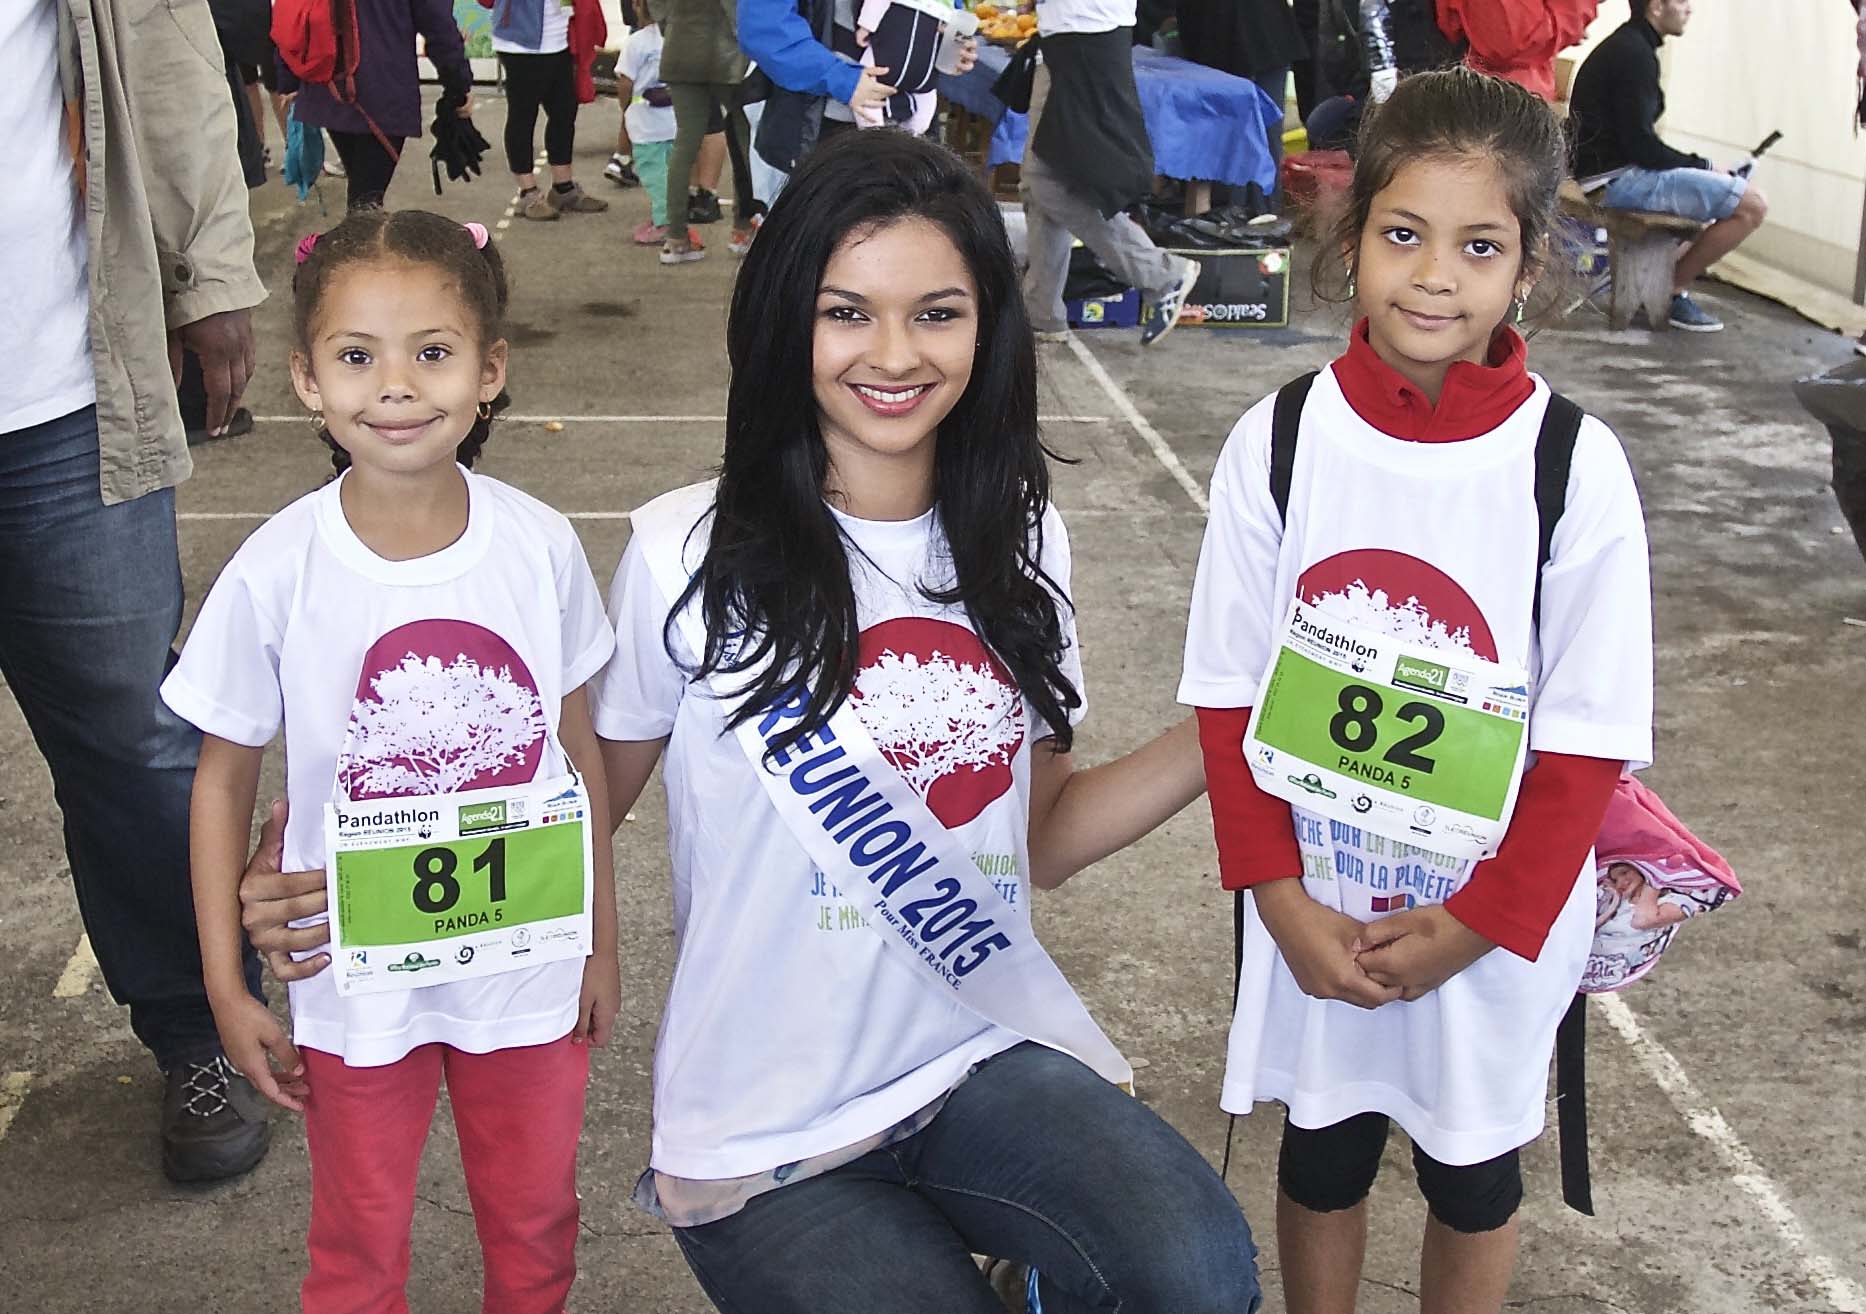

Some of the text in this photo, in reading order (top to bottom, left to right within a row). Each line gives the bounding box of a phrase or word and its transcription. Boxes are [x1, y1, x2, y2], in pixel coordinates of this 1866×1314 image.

[1292, 612, 1378, 660] Pandathlon
[1329, 684, 1445, 774] 82
[1338, 756, 1411, 790] PANDA 5
[338, 808, 440, 829] Pandathlon
[412, 837, 506, 914] 81
[1370, 863, 1388, 890] LA
[434, 909, 503, 934] PANDA 5
[874, 900, 962, 990] Pour Miss FRANCE
[899, 877, 1012, 977] 2015
